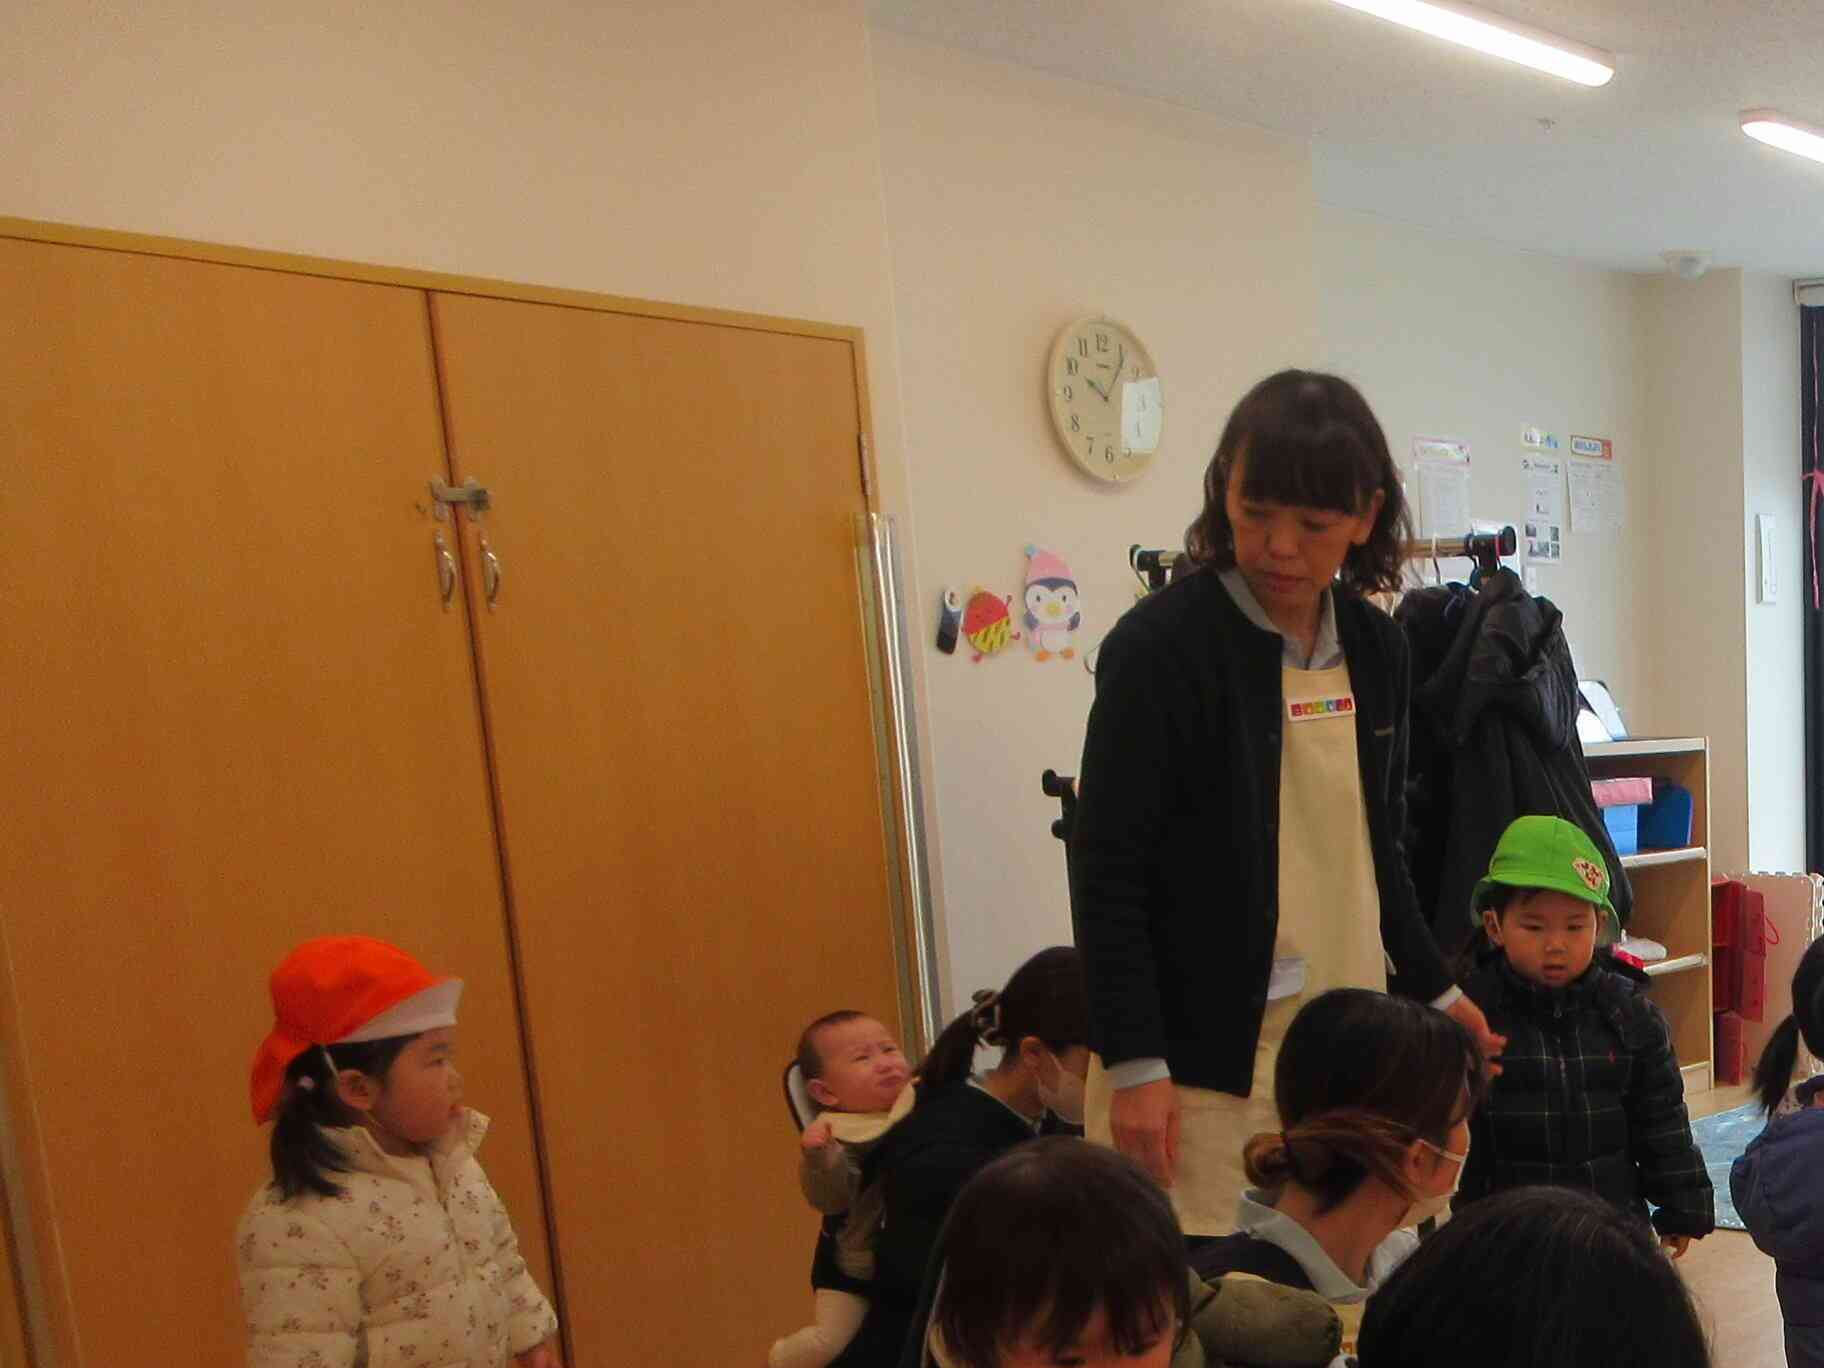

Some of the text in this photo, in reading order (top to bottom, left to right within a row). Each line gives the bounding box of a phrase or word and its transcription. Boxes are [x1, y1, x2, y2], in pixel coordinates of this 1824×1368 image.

[1077, 338, 1088, 358] 11
[1095, 334, 1110, 352] 12
[1066, 357, 1079, 376] 10
[1063, 385, 1073, 402] 9
[1071, 415, 1081, 432] 8
[1085, 436, 1095, 456] 7
[1104, 446, 1115, 462] 6
